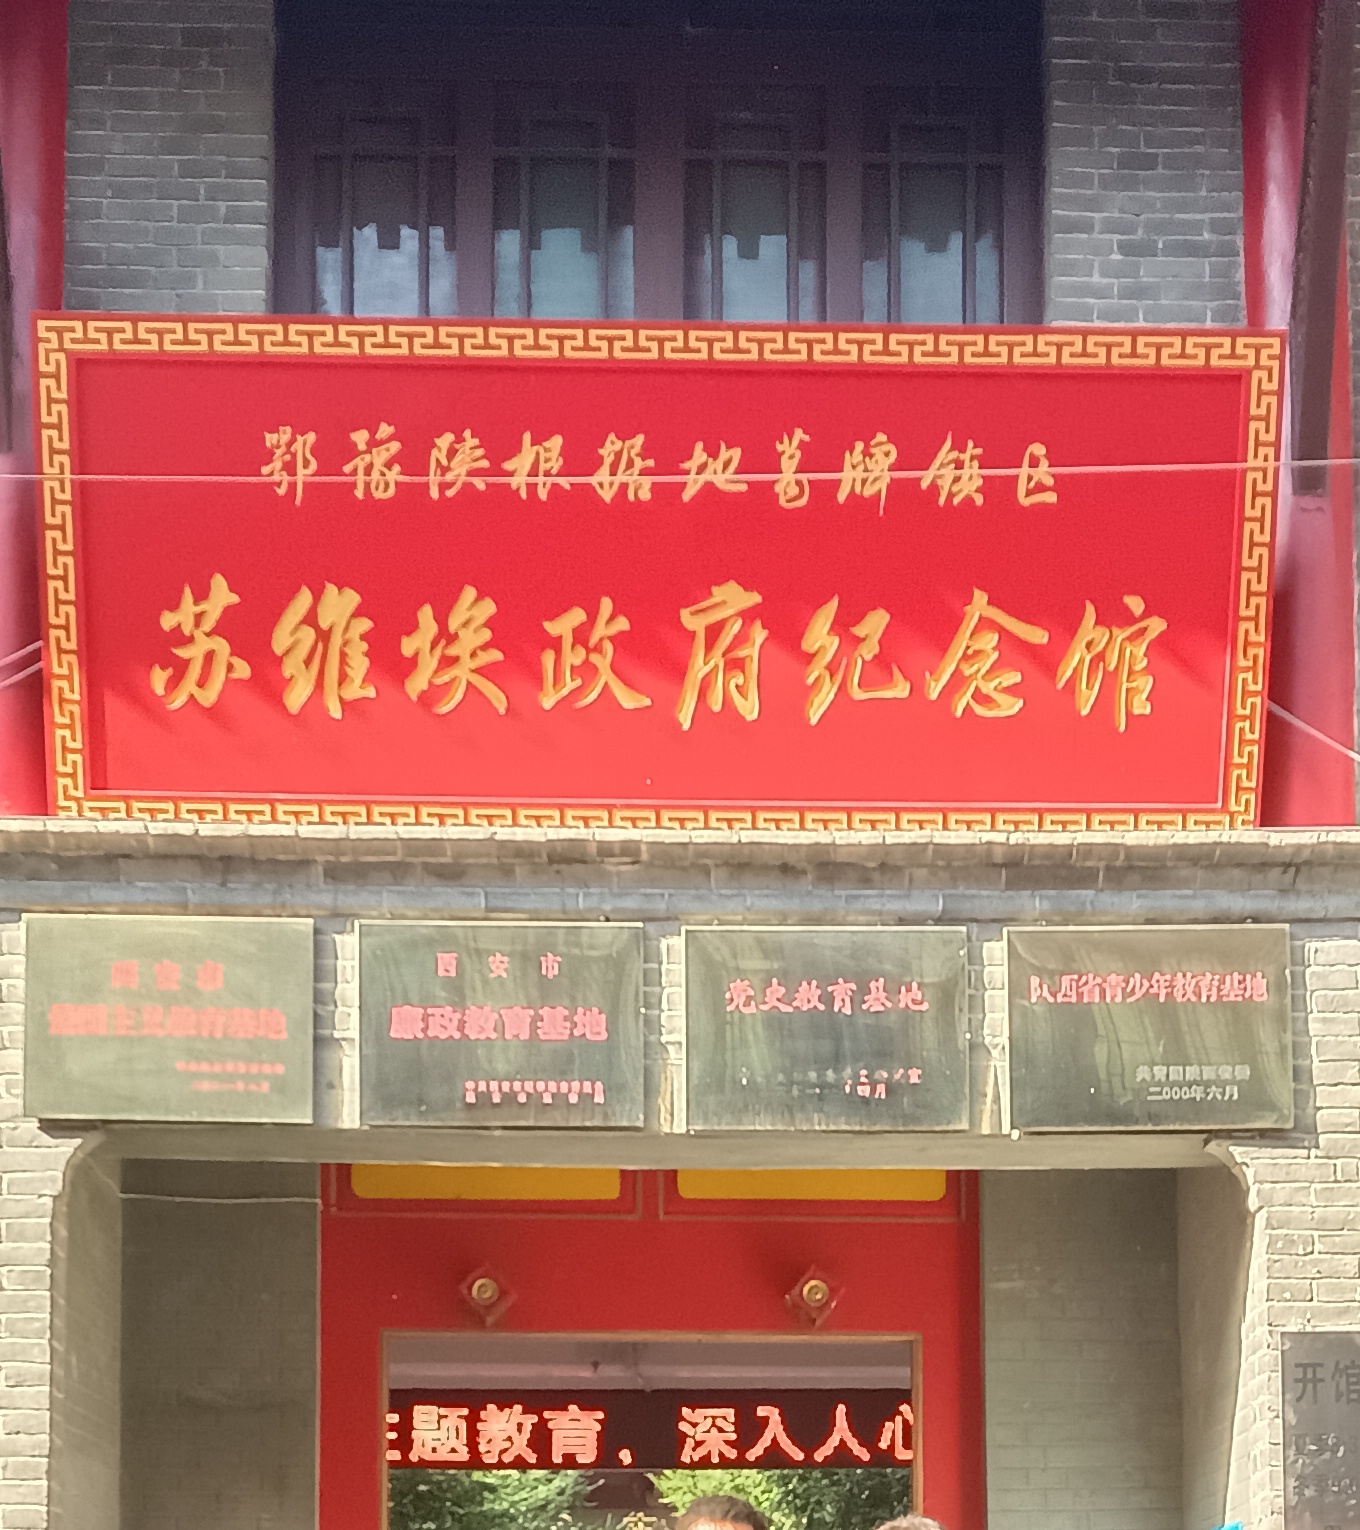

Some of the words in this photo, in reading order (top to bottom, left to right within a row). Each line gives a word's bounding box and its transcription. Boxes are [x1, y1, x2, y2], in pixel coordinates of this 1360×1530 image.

[261, 422, 1058, 515] 鄂豫陕根据地葛牌镇区
[150, 573, 1168, 733] 苏维埃政府纪念馆
[437, 952, 562, 979] 西安市
[726, 977, 930, 1014] 党史教育基地
[389, 1004, 609, 1041] 廉政教育基地
